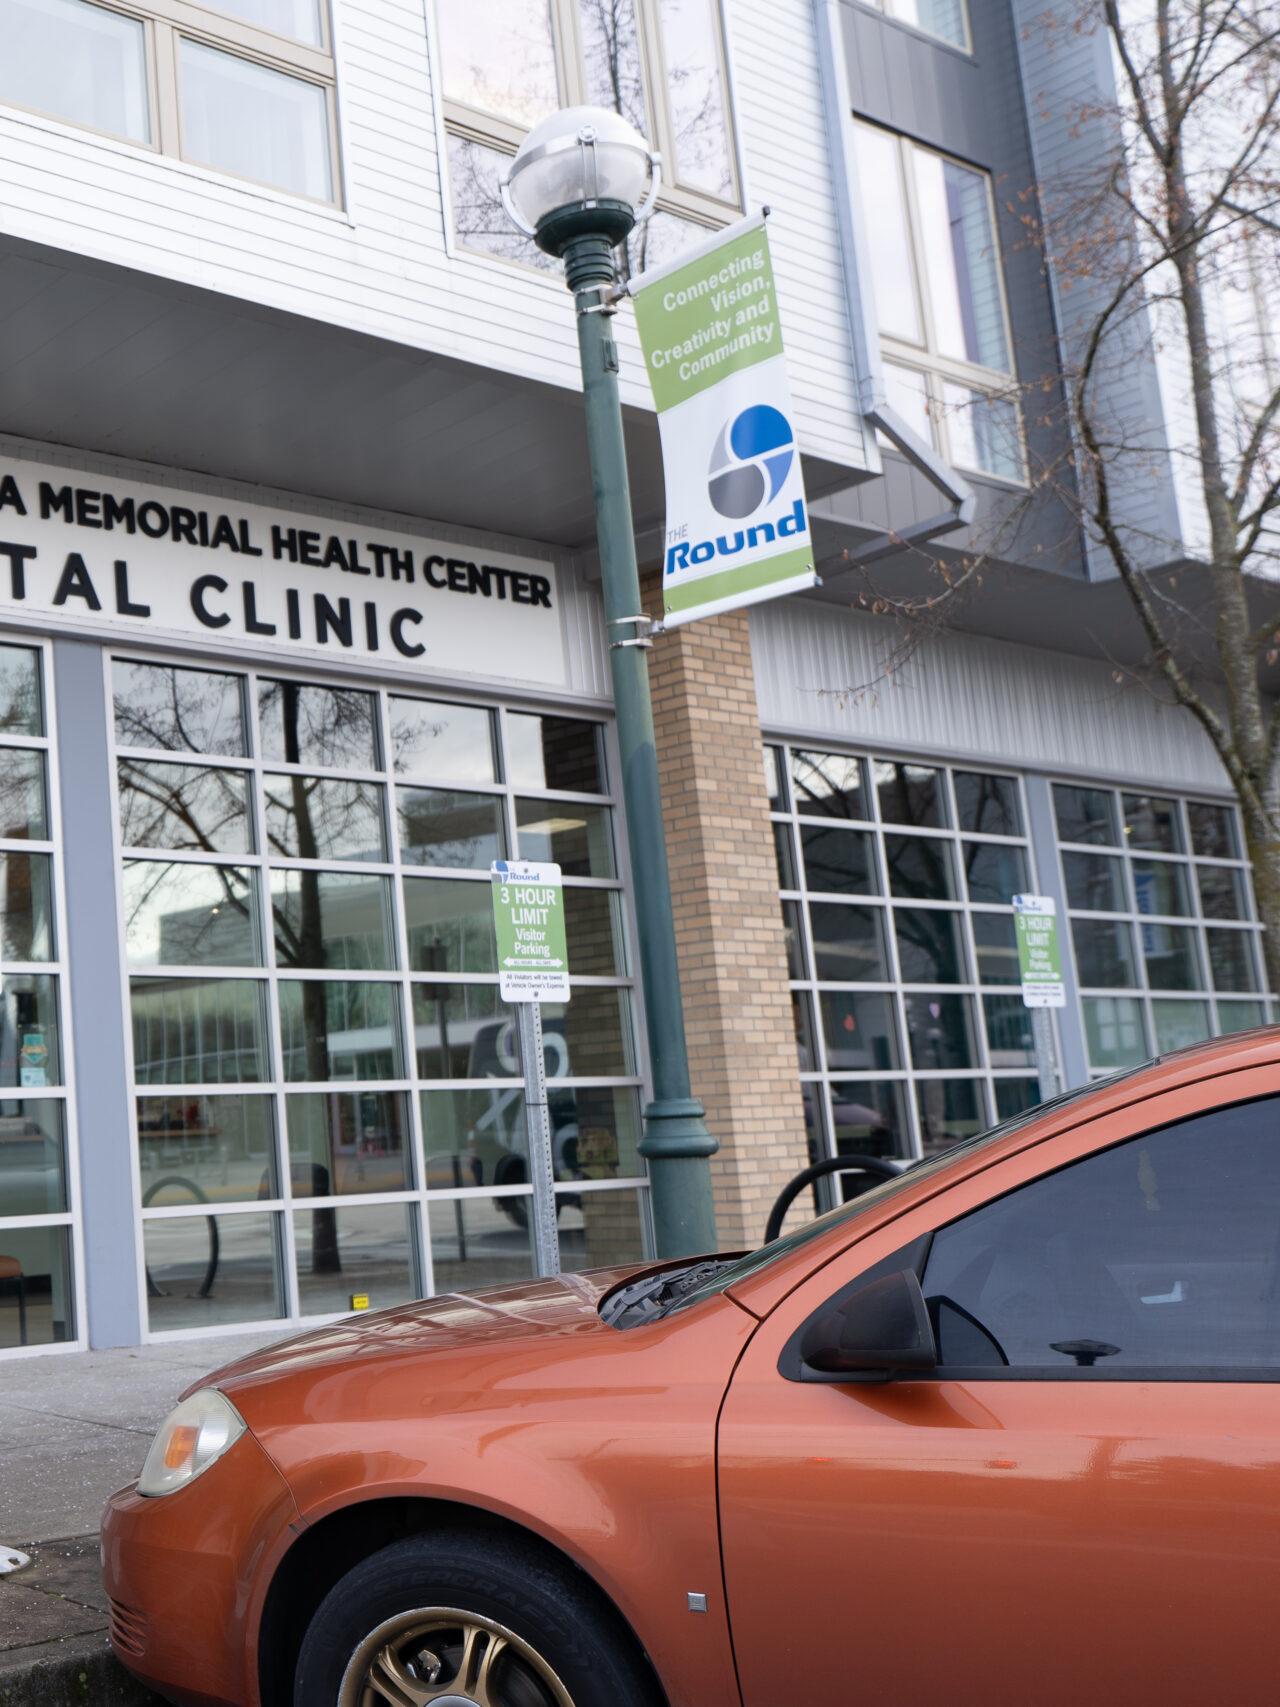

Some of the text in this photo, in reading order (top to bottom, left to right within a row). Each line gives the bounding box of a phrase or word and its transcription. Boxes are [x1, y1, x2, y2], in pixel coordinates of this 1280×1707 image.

[663, 249, 766, 312] Connecting
[710, 276, 771, 313] Vision,
[651, 294, 771, 369] Creativity and
[679, 322, 774, 381] Community
[39, 481, 262, 556] MEMORIAL
[271, 525, 415, 583] HEALTH
[423, 555, 552, 608] CENTER
[666, 499, 806, 575] Round
[667, 523, 689, 543] THE
[190, 574, 427, 658] CLINIC
[510, 872, 540, 881] Round
[500, 887, 556, 905] 3 HOUR
[511, 908, 549, 925] LIMIT
[1019, 916, 1053, 931] 3 HOUR
[515, 928, 546, 941] Visitor
[514, 942, 551, 958] Parking
